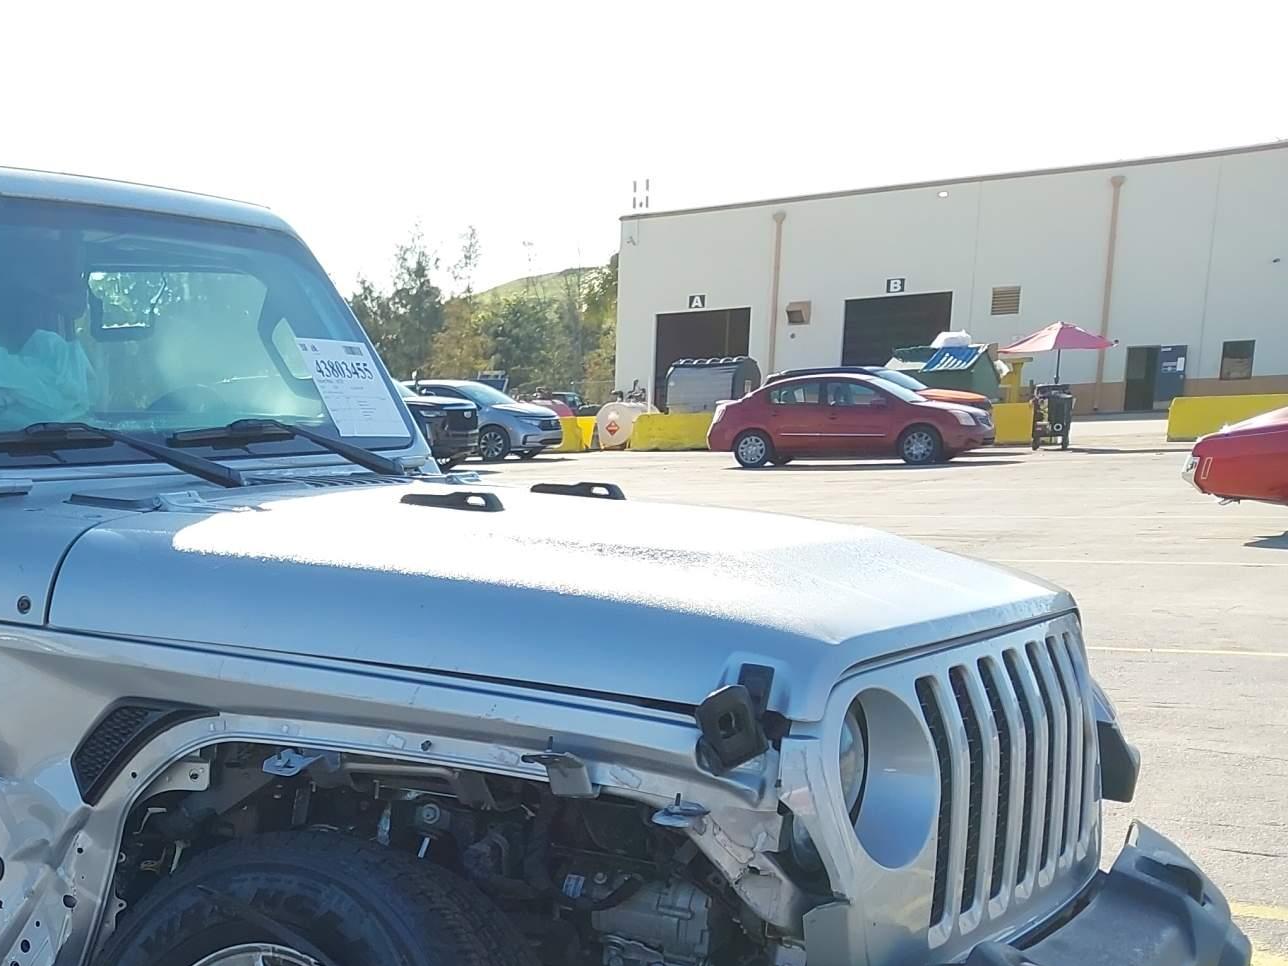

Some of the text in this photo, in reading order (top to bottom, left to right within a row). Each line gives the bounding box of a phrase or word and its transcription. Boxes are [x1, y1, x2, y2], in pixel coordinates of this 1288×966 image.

[890, 279, 902, 292] B
[691, 296, 703, 307] A
[314, 359, 374, 380] 43803455
